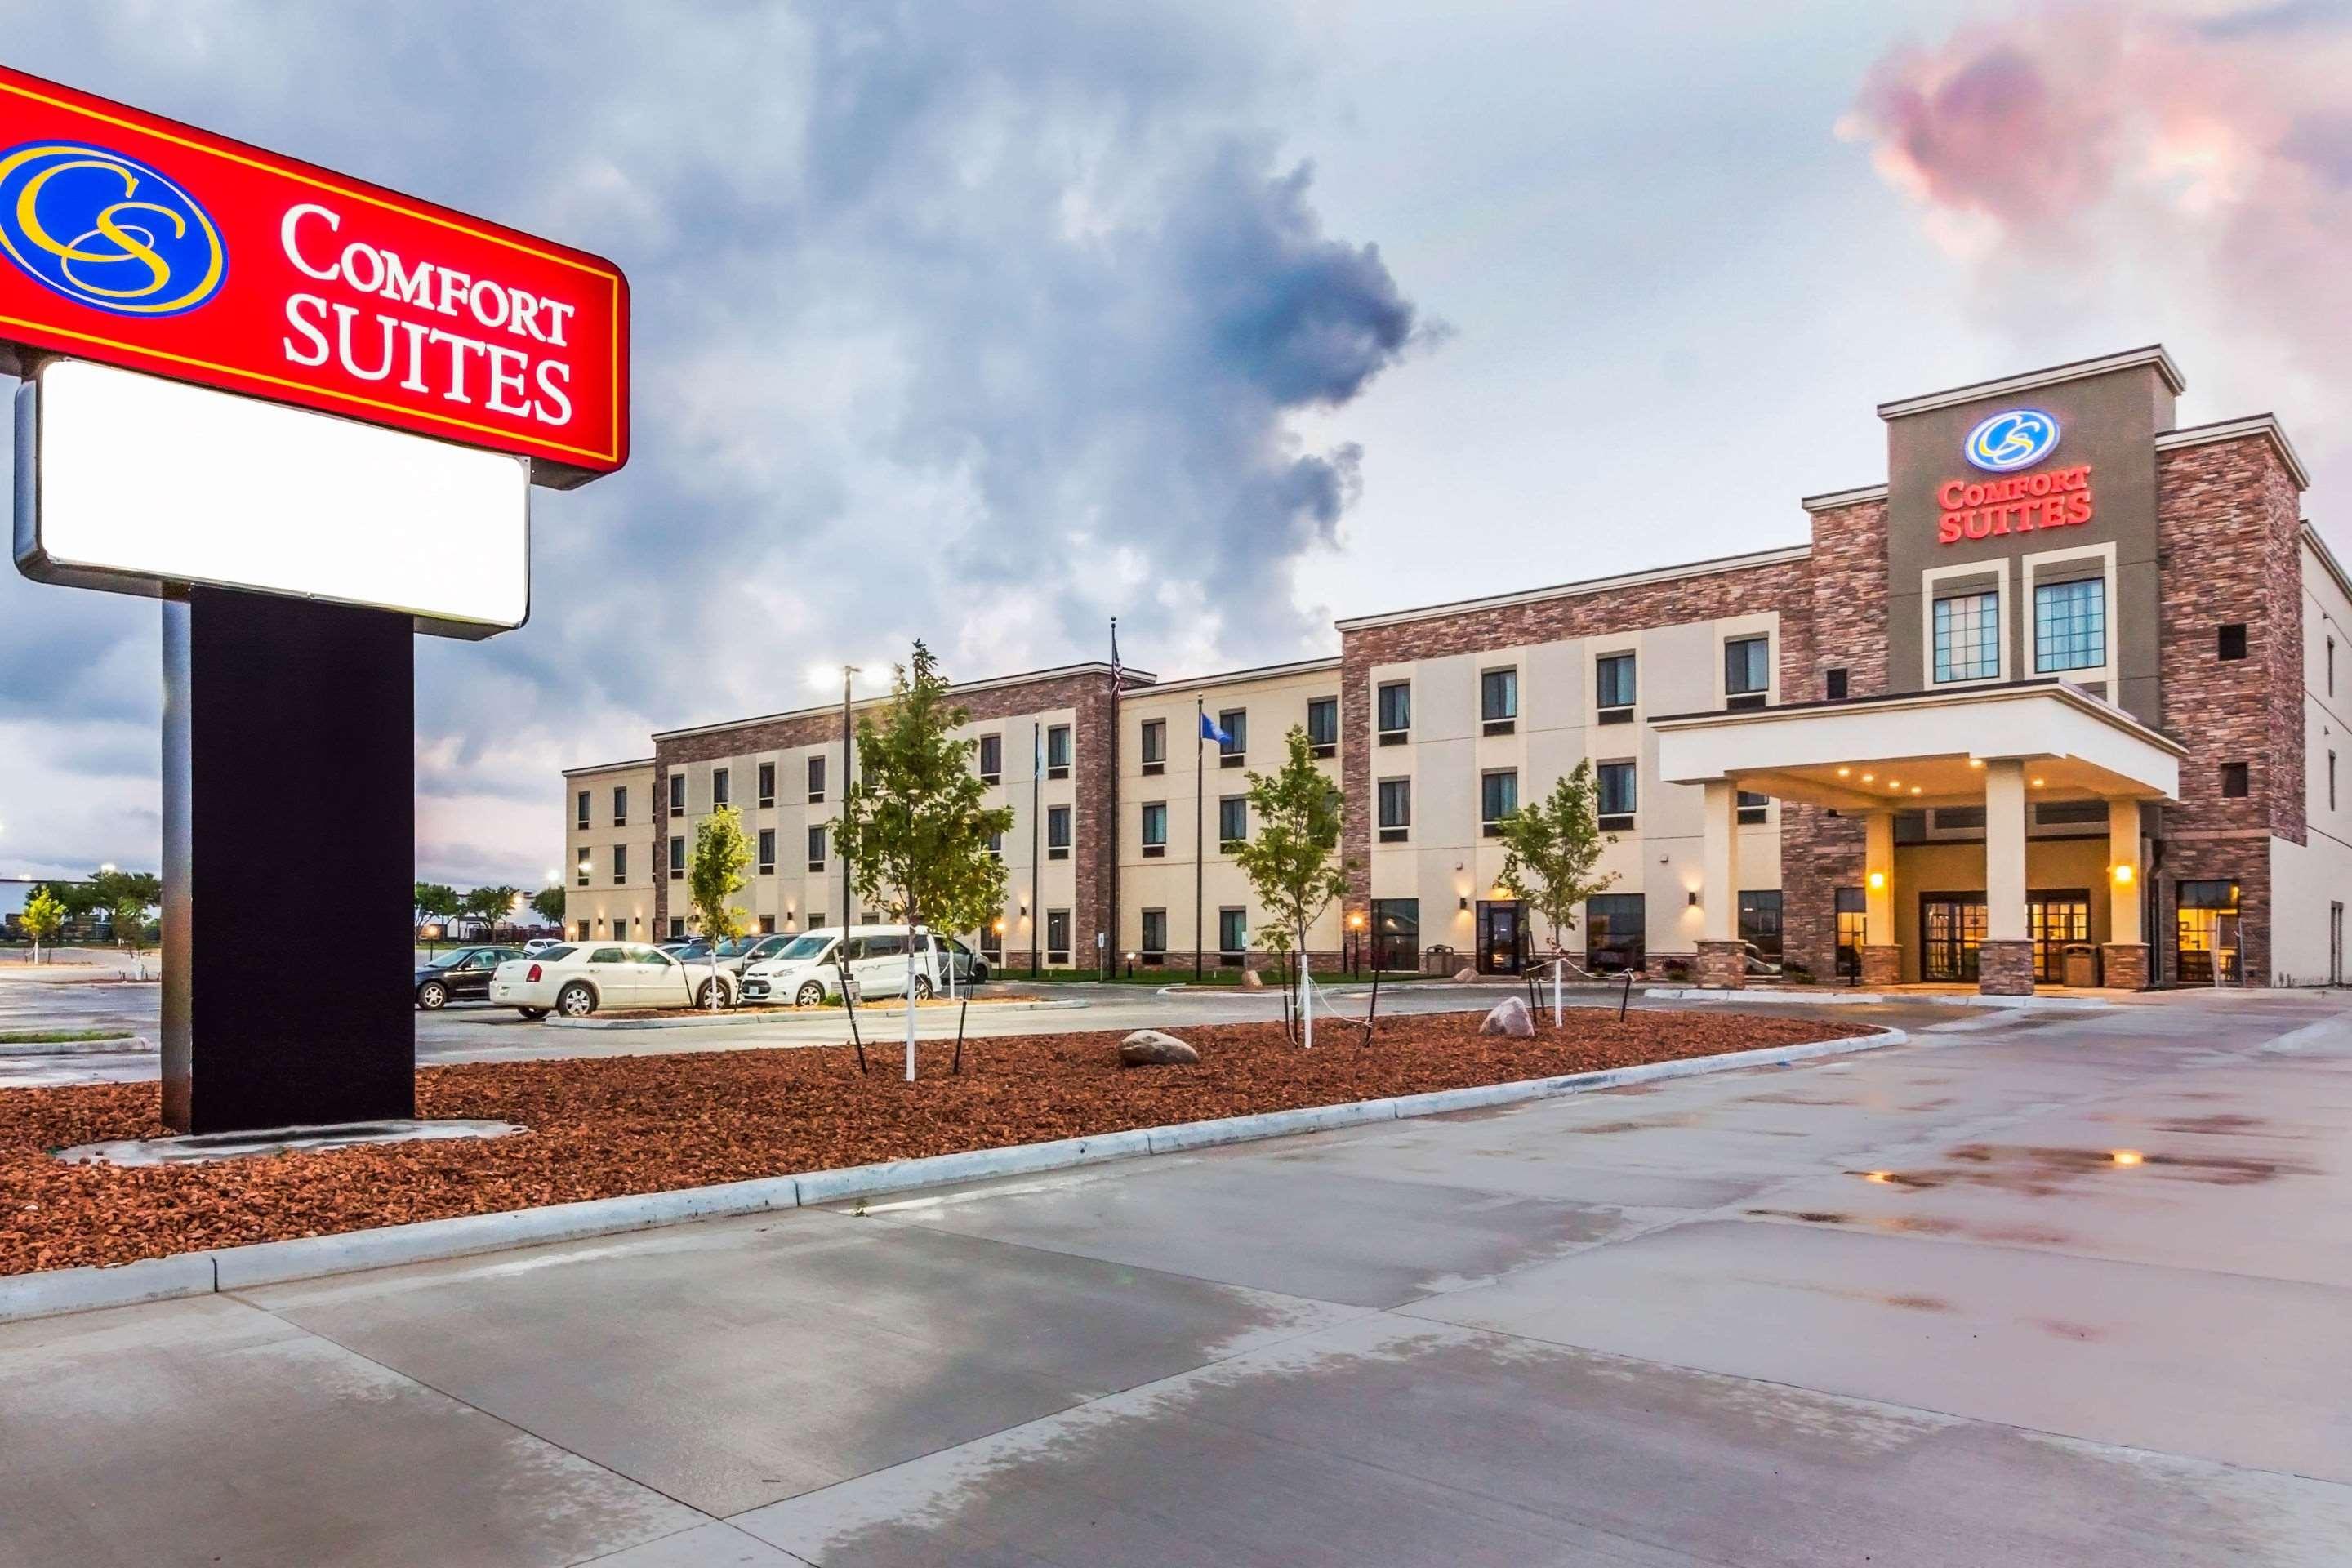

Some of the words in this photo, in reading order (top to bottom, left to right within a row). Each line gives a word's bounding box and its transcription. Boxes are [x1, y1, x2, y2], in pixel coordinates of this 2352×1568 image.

[281, 203, 574, 347] COMFORT
[283, 292, 572, 426] SUITES
[1938, 466, 2091, 510] COMFORT
[1939, 492, 2091, 544] SUITES
